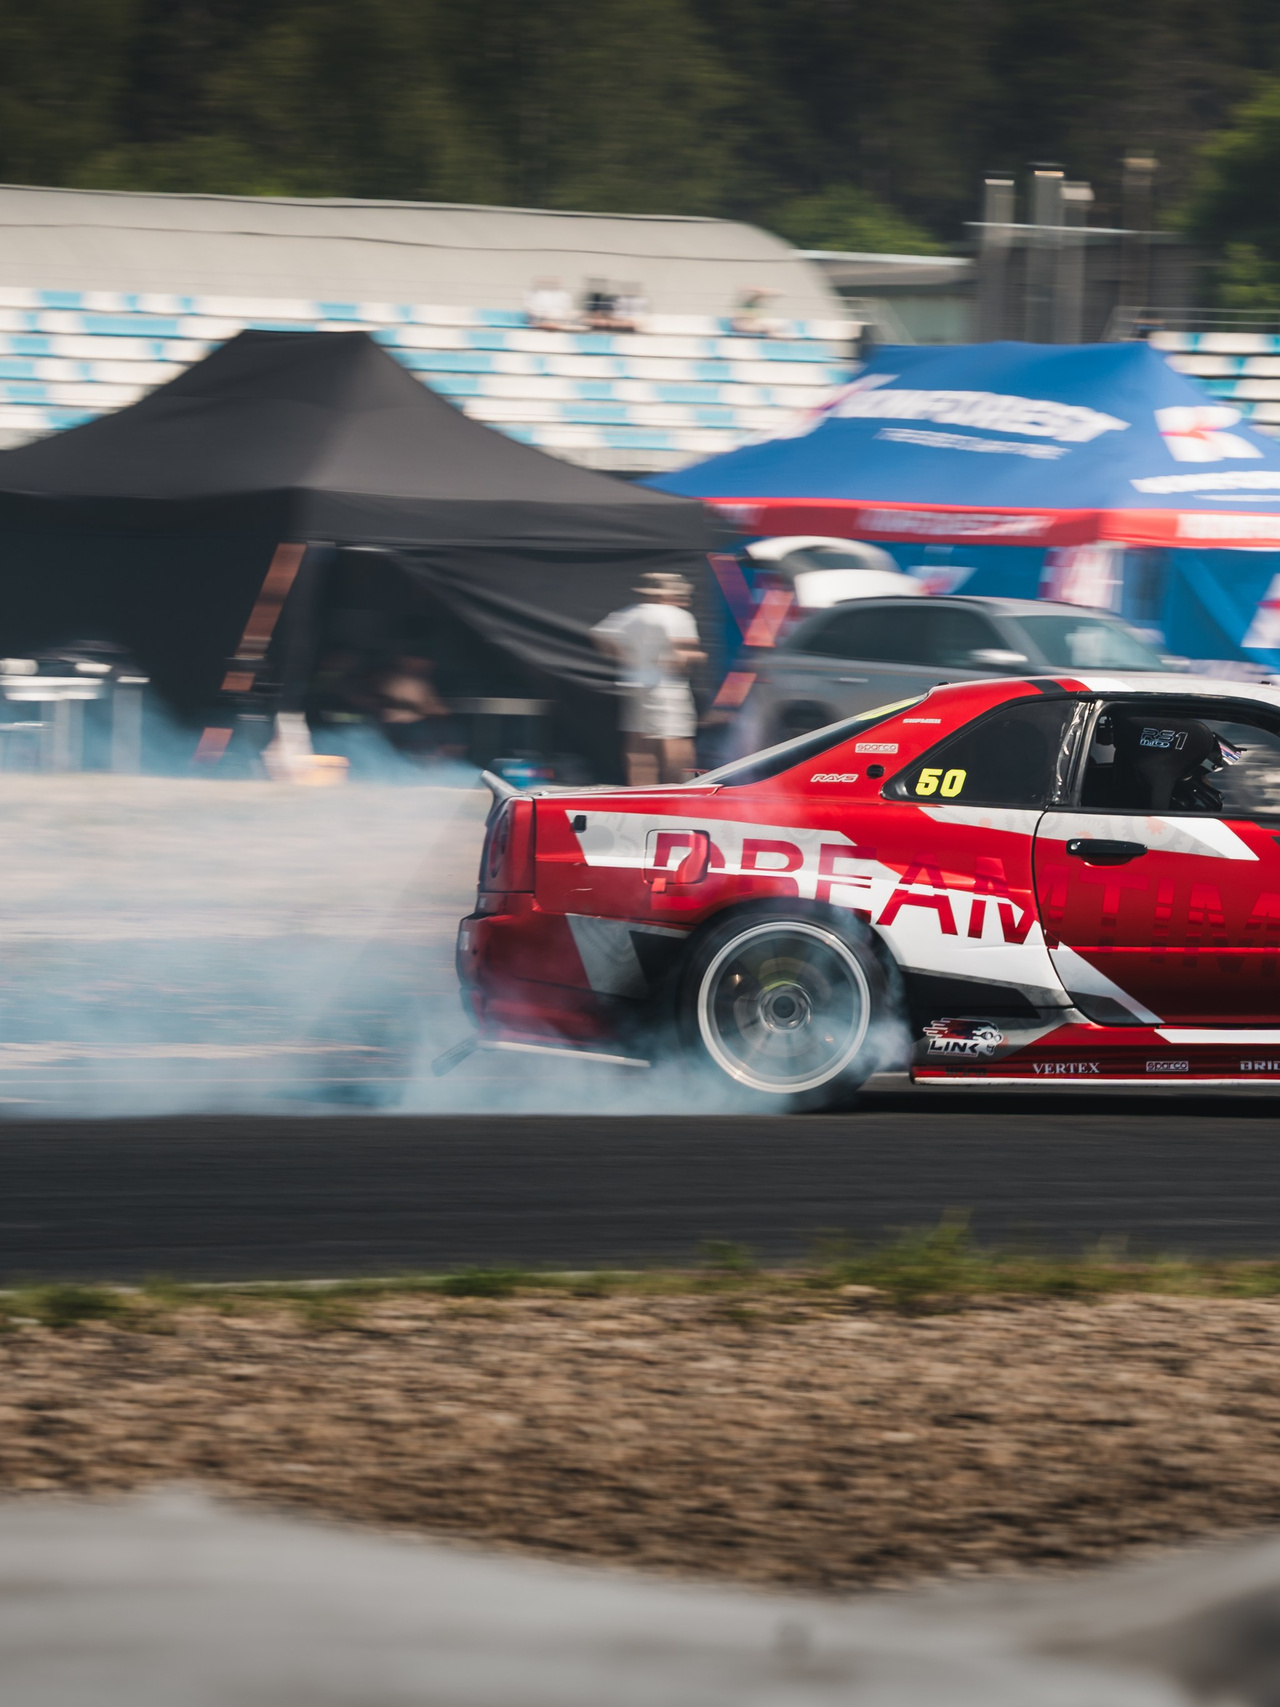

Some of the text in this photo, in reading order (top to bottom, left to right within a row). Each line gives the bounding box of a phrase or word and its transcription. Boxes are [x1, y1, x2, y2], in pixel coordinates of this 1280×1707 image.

[857, 744, 896, 752] sparco
[810, 773, 858, 782] RAYS
[915, 768, 967, 797] 50
[1033, 1062, 1100, 1074] VERTEX
[1147, 1061, 1188, 1072] sparco
